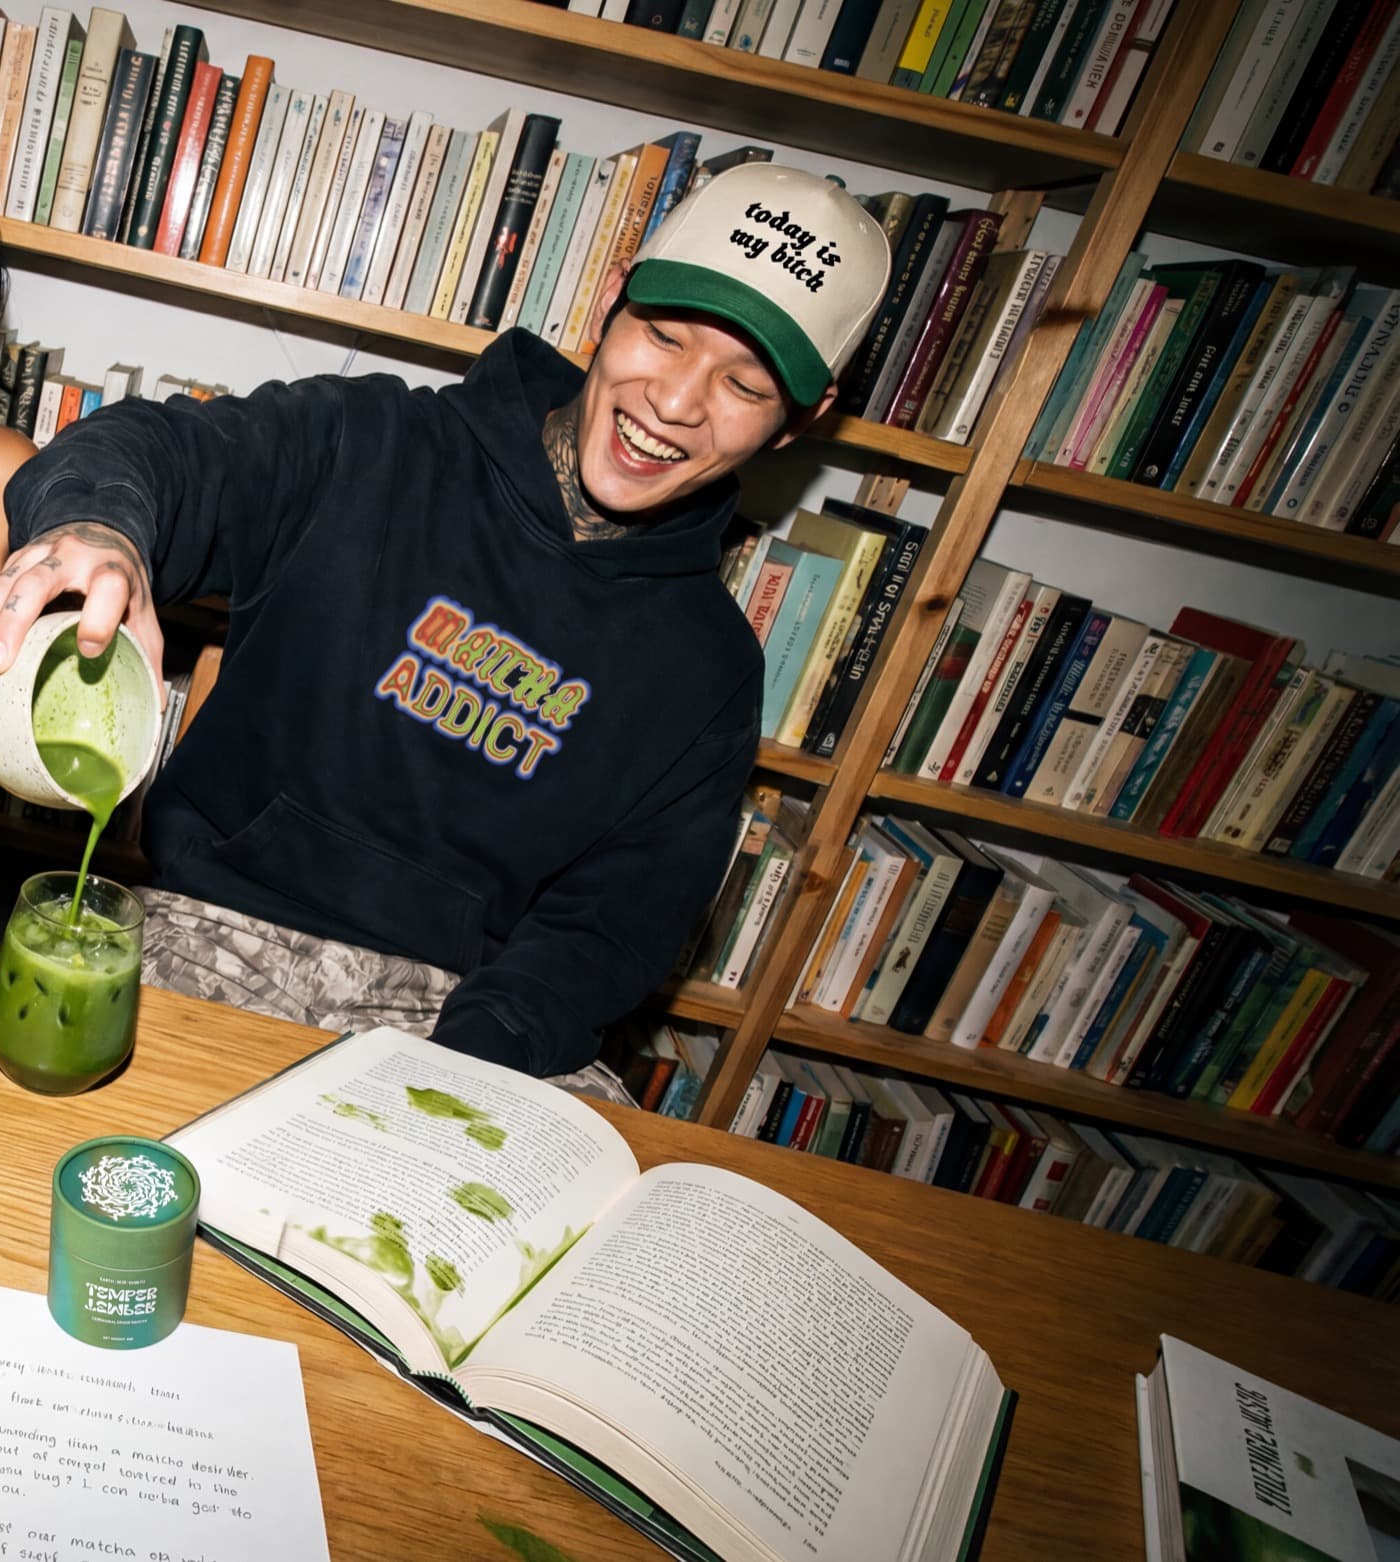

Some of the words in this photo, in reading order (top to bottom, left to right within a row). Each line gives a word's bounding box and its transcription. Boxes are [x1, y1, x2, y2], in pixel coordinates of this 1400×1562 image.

[729, 228, 769, 260] my
[770, 242, 826, 293] bitch
[744, 202, 816, 251] today
[817, 241, 842, 267] is
[411, 600, 589, 728] MATCHA
[378, 654, 557, 776] ADDICT
[85, 1282, 158, 1302] TEMPER
[69, 1537, 137, 1559] matcha
